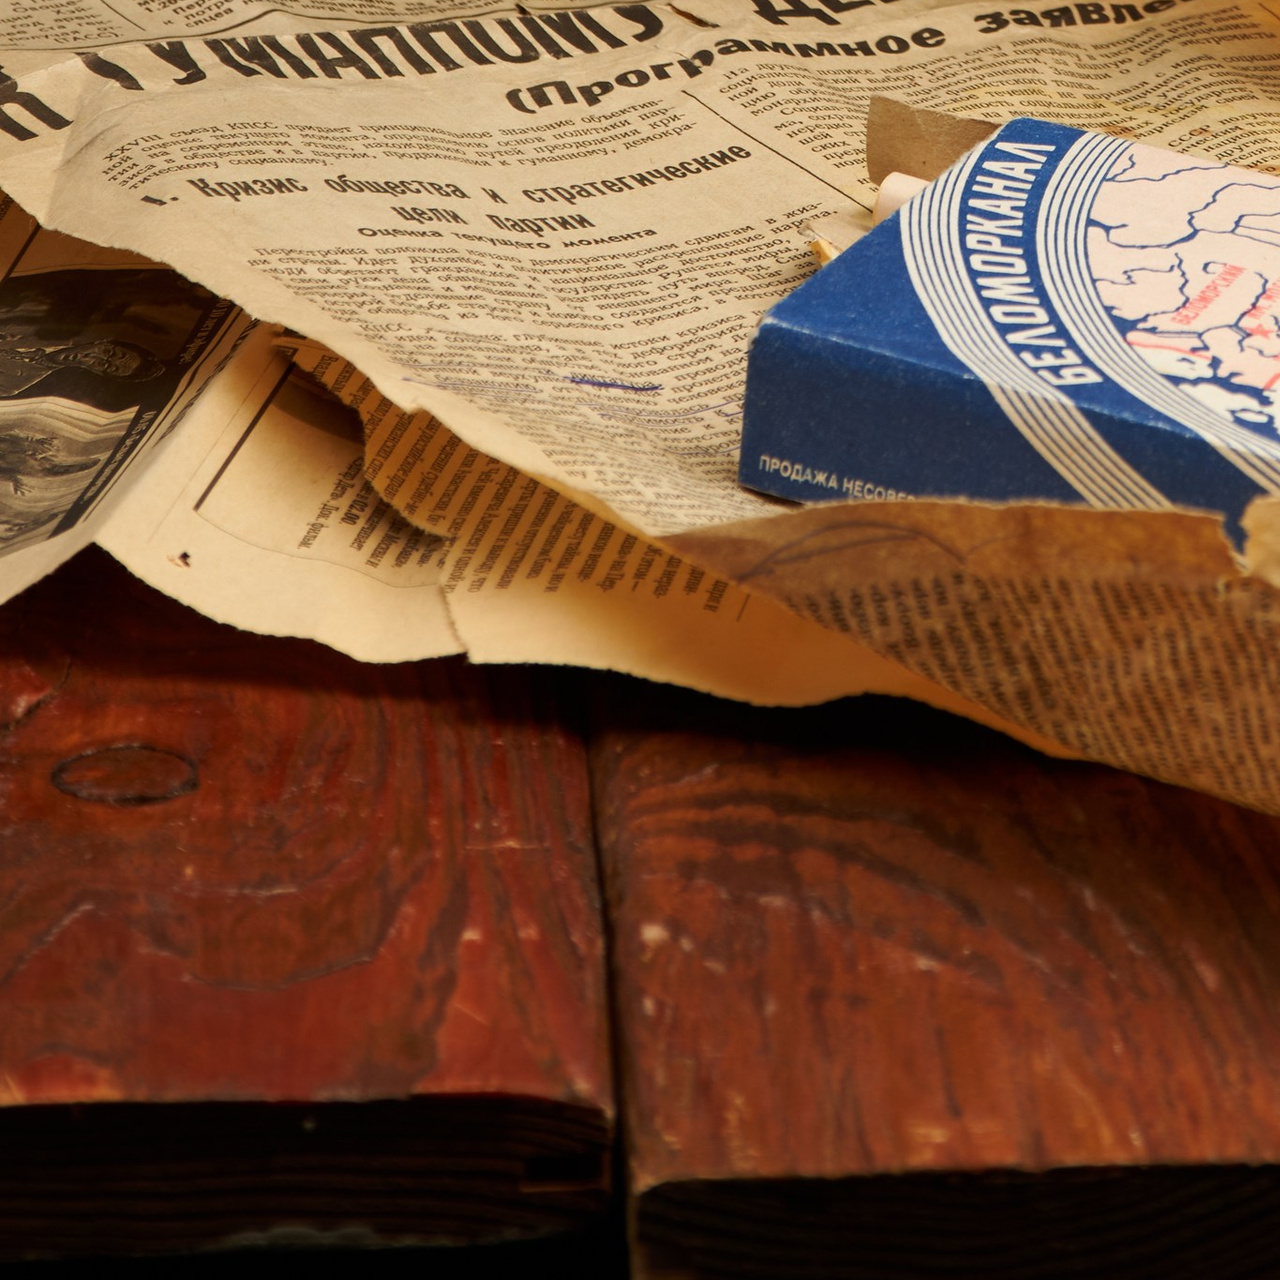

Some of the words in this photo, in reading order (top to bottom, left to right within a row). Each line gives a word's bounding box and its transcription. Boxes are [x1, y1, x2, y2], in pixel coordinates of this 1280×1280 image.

[506, 27, 947, 115] (Программное
[101, 155, 134, 176] ной
[141, 137, 204, 153] оценке
[210, 131, 291, 142] текущего
[300, 132, 376, 143] момента,
[382, 132, 488, 150] определению
[497, 134, 546, 148] основ
[552, 119, 632, 140] политики
[637, 105, 677, 122] пар-
[103, 134, 163, 162] XXVIII
[170, 125, 221, 140] съезд
[226, 121, 279, 131] КПСС
[285, 122, 352, 135] придает
[357, 123, 493, 140] принципиальное
[499, 117, 576, 137] значение
[581, 98, 665, 124] объектив-
[1167, 124, 1212, 149] СССР
[128, 159, 219, 191] тическому
[228, 157, 334, 168] социализму.
[186, 174, 309, 202] Кризис
[324, 174, 471, 201] общества
[479, 187, 509, 205] и
[521, 145, 752, 206] стратегические
[253, 246, 368, 257] Перестройка
[375, 245, 459, 255] положила
[529, 241, 679, 268] демократическим
[683, 223, 756, 246] сдвигам
[781, 201, 823, 221] жиз-
[357, 227, 445, 240] Оценка
[451, 232, 552, 251] текущего
[561, 228, 658, 249] момента
[391, 204, 468, 227] цели
[485, 212, 596, 238] партии
[966, 142, 1103, 385] БЕЛОМОРКАНАЛ
[759, 454, 838, 490] ПРОДАЖА
